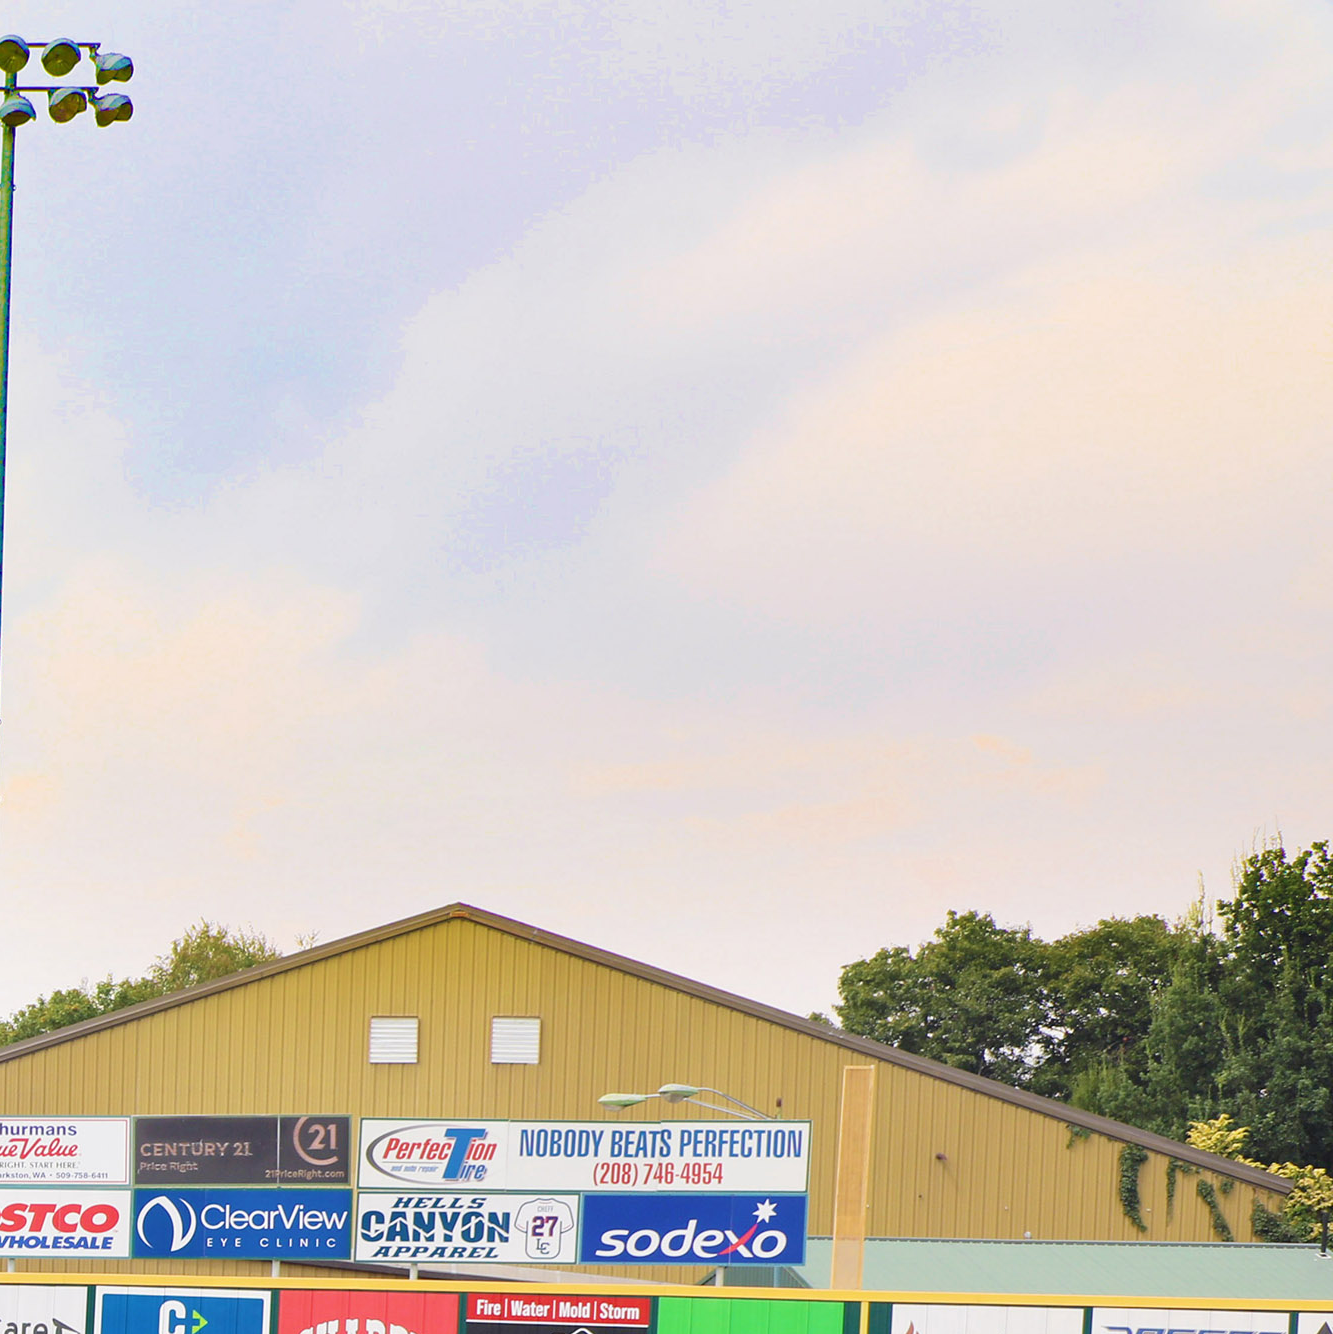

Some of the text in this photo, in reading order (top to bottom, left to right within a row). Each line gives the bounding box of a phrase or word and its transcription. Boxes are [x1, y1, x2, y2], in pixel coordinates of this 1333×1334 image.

[140, 1142, 253, 1157] CENTURY 21
[519, 1129, 802, 1158] NOBODY BEATS PERFECTION
[139, 1161, 198, 1173] Price Right
[265, 1169, 345, 1179] 21PriceRight.com
[592, 1162, 724, 1186] (208) 746-4954
[391, 1197, 487, 1209] HELLS
[201, 1204, 347, 1231] ClearView
[360, 1210, 510, 1243] CANYON
[531, 1216, 559, 1237] 27
[207, 1238, 337, 1248] EYE CLINIC
[595, 1220, 787, 1259] sodexo
[372, 1246, 499, 1258] APPAREL
[477, 1299, 640, 1320] Fire Water Mold Storm
